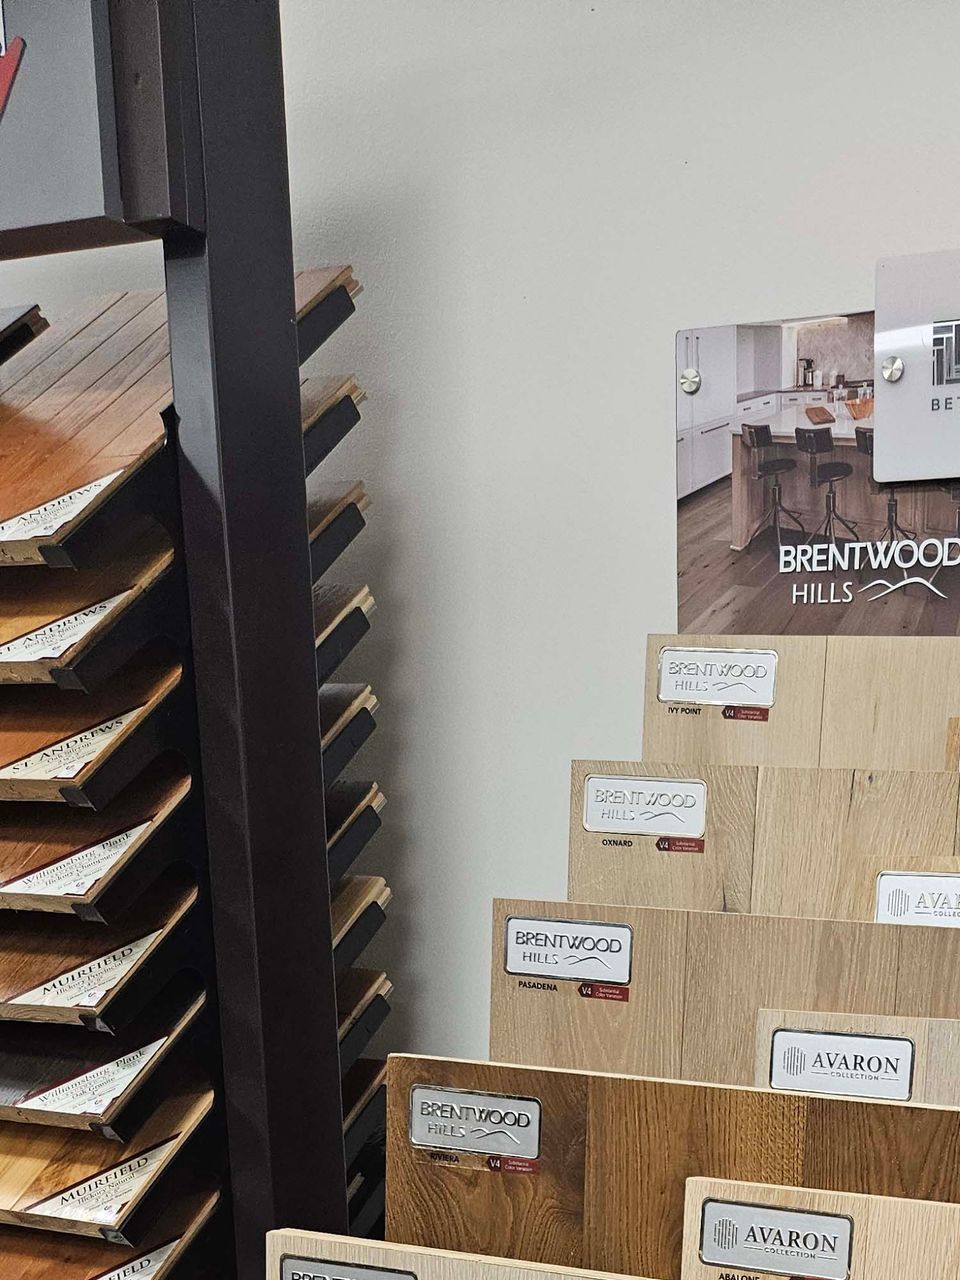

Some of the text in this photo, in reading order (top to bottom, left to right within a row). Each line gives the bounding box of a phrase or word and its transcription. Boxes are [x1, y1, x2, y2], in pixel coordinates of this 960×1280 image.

[16, 482, 101, 524] ANDREWS
[792, 582, 853, 604] HILLS
[21, 603, 107, 645] ANDREWS
[57, 619, 85, 634] Natural
[668, 661, 768, 678] BRENTWOOD
[675, 680, 708, 692] HILLS
[681, 707, 702, 715] POINT
[725, 709, 734, 717] V4
[38, 718, 123, 760] ANDREWS
[46, 753, 62, 763] Oak
[594, 789, 697, 808] BRENTWOOD
[601, 808, 635, 820] HILLS
[602, 839, 633, 848] OXNARD
[660, 841, 669, 849] V4
[22, 849, 95, 885] Williamsburg
[101, 832, 132, 850] Plank
[515, 931, 622, 953] BRENTWOOD
[522, 951, 559, 965] HILLS
[42, 947, 133, 993] MUIRFIELD
[56, 978, 84, 995] Hickory
[87, 960, 123, 980] Provincial
[518, 981, 558, 992] PASADENA
[581, 986, 592, 995] V4
[811, 1052, 900, 1074] AVARON
[39, 1065, 110, 1103] Williamsburg
[115, 1049, 144, 1067] Plank
[830, 1071, 879, 1081] COLLECTION
[71, 1089, 87, 1099] Oak
[420, 1101, 531, 1128] BRENTWOOD
[428, 1122, 465, 1137] HILLS
[430, 1152, 460, 1163] RIVIERA
[490, 1159, 500, 1168] V4
[58, 1157, 148, 1204] MUIRFIELD
[77, 1187, 107, 1204] Hickory
[107, 1173, 134, 1189] Natural
[744, 1225, 839, 1253] AVARON
[764, 1246, 816, 1259] COLLECTION
